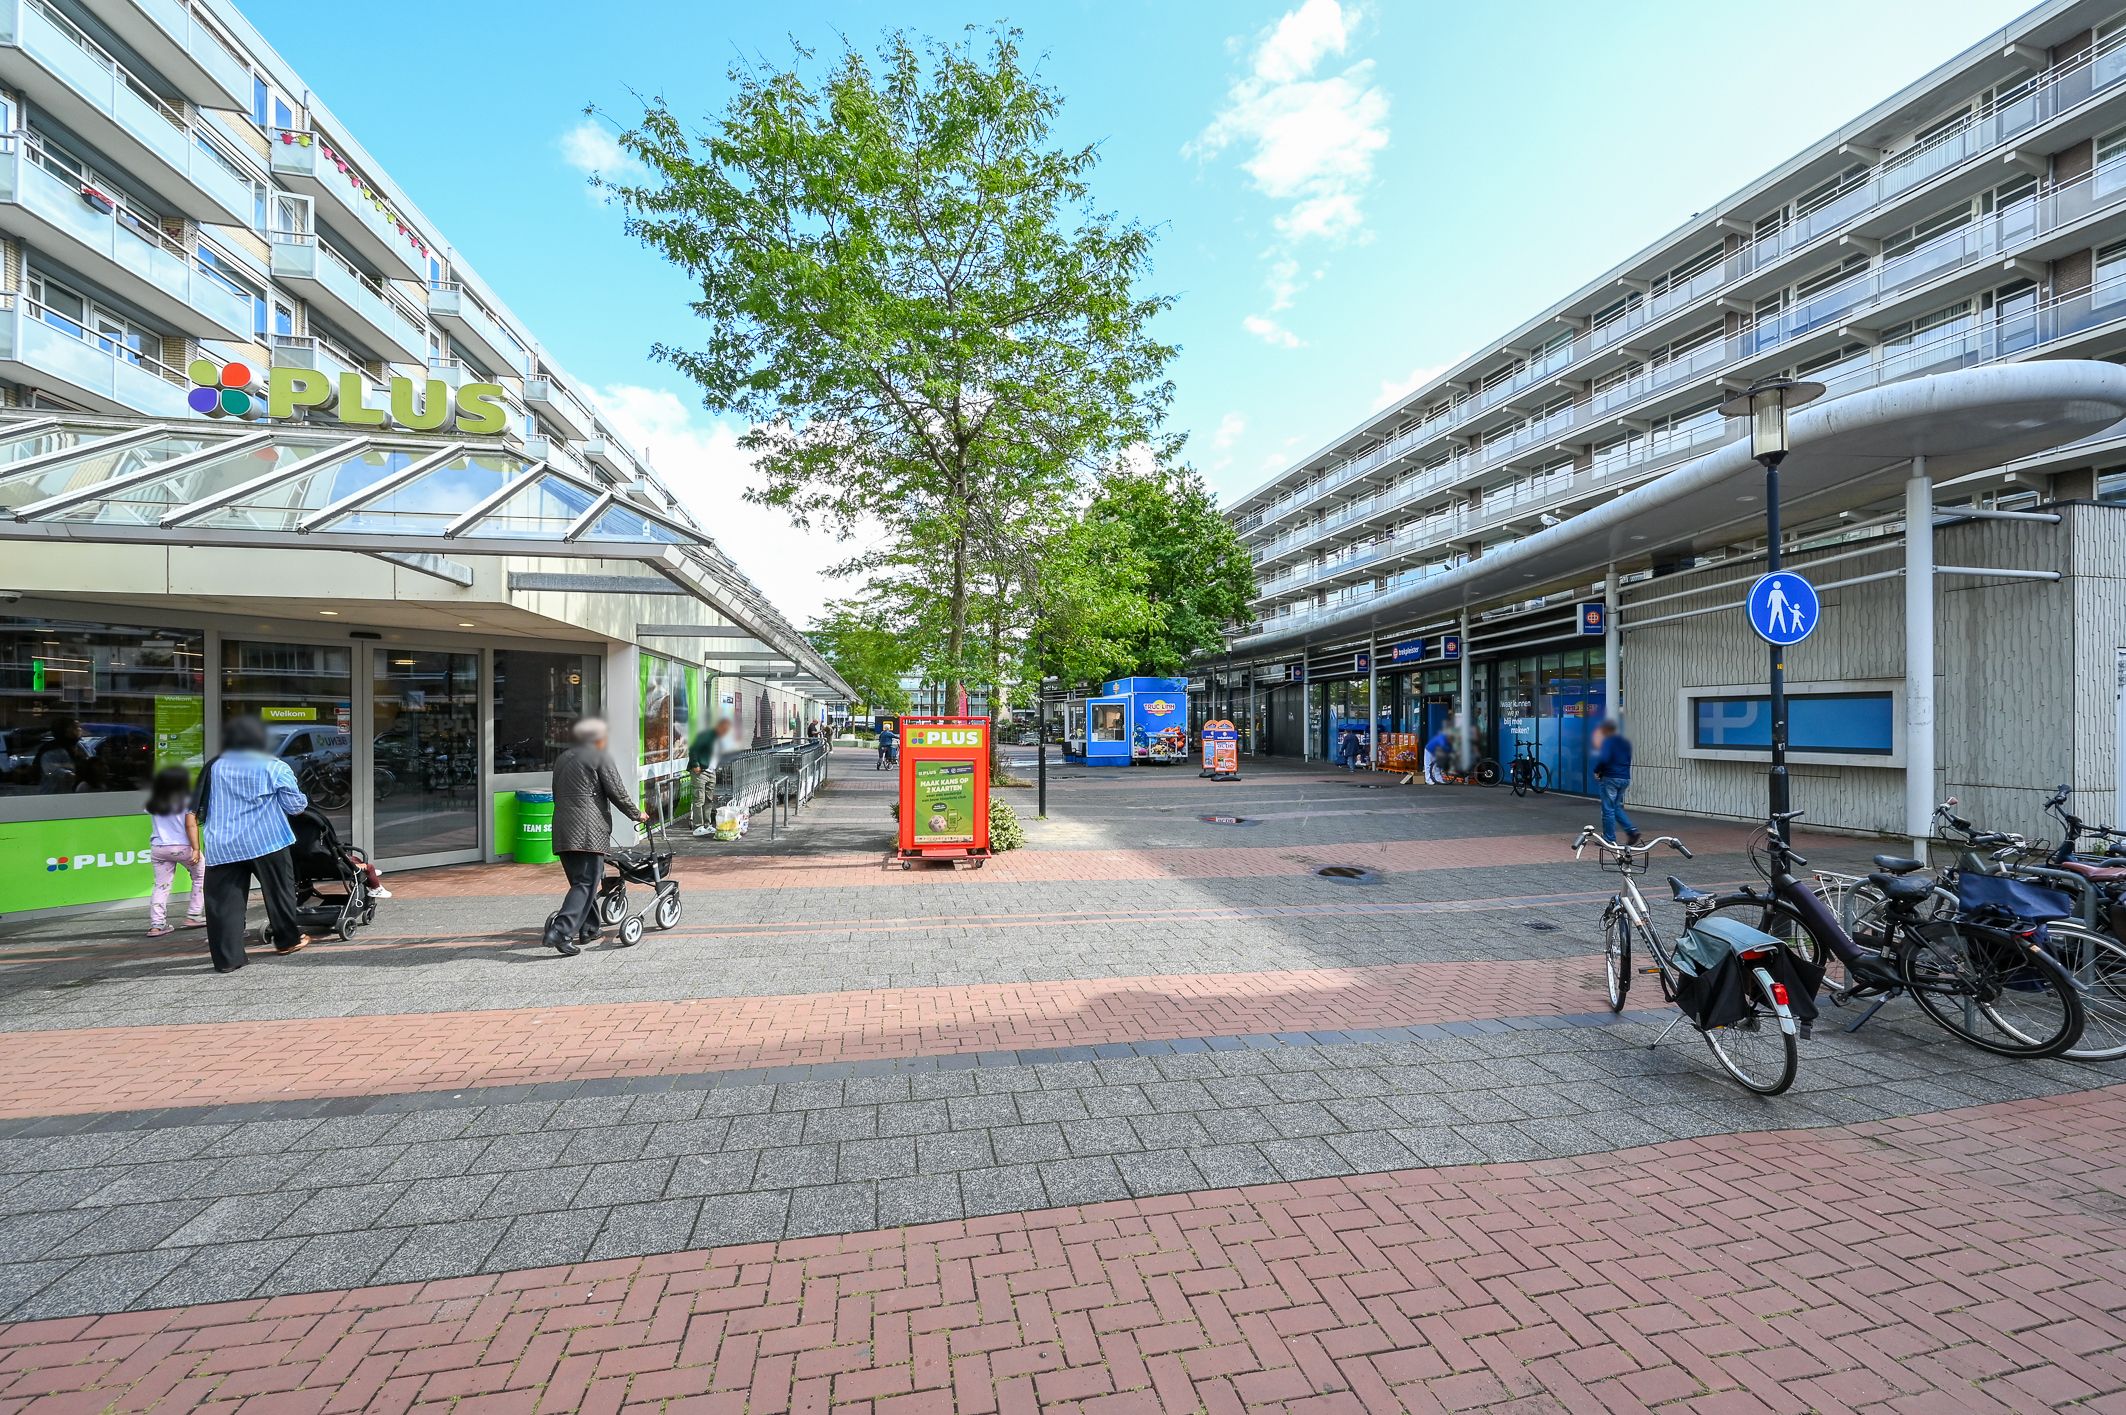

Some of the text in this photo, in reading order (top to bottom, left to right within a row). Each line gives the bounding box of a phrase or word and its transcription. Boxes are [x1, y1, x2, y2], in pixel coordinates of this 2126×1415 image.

[269, 366, 508, 435] PLUS
[1398, 646, 1420, 656] trekpleister
[927, 731, 978, 745] PLUS
[940, 778, 959, 786] KANS
[931, 784, 962, 793] KAARTEN
[523, 823, 541, 832] TEAM
[73, 849, 152, 870] PLUS
